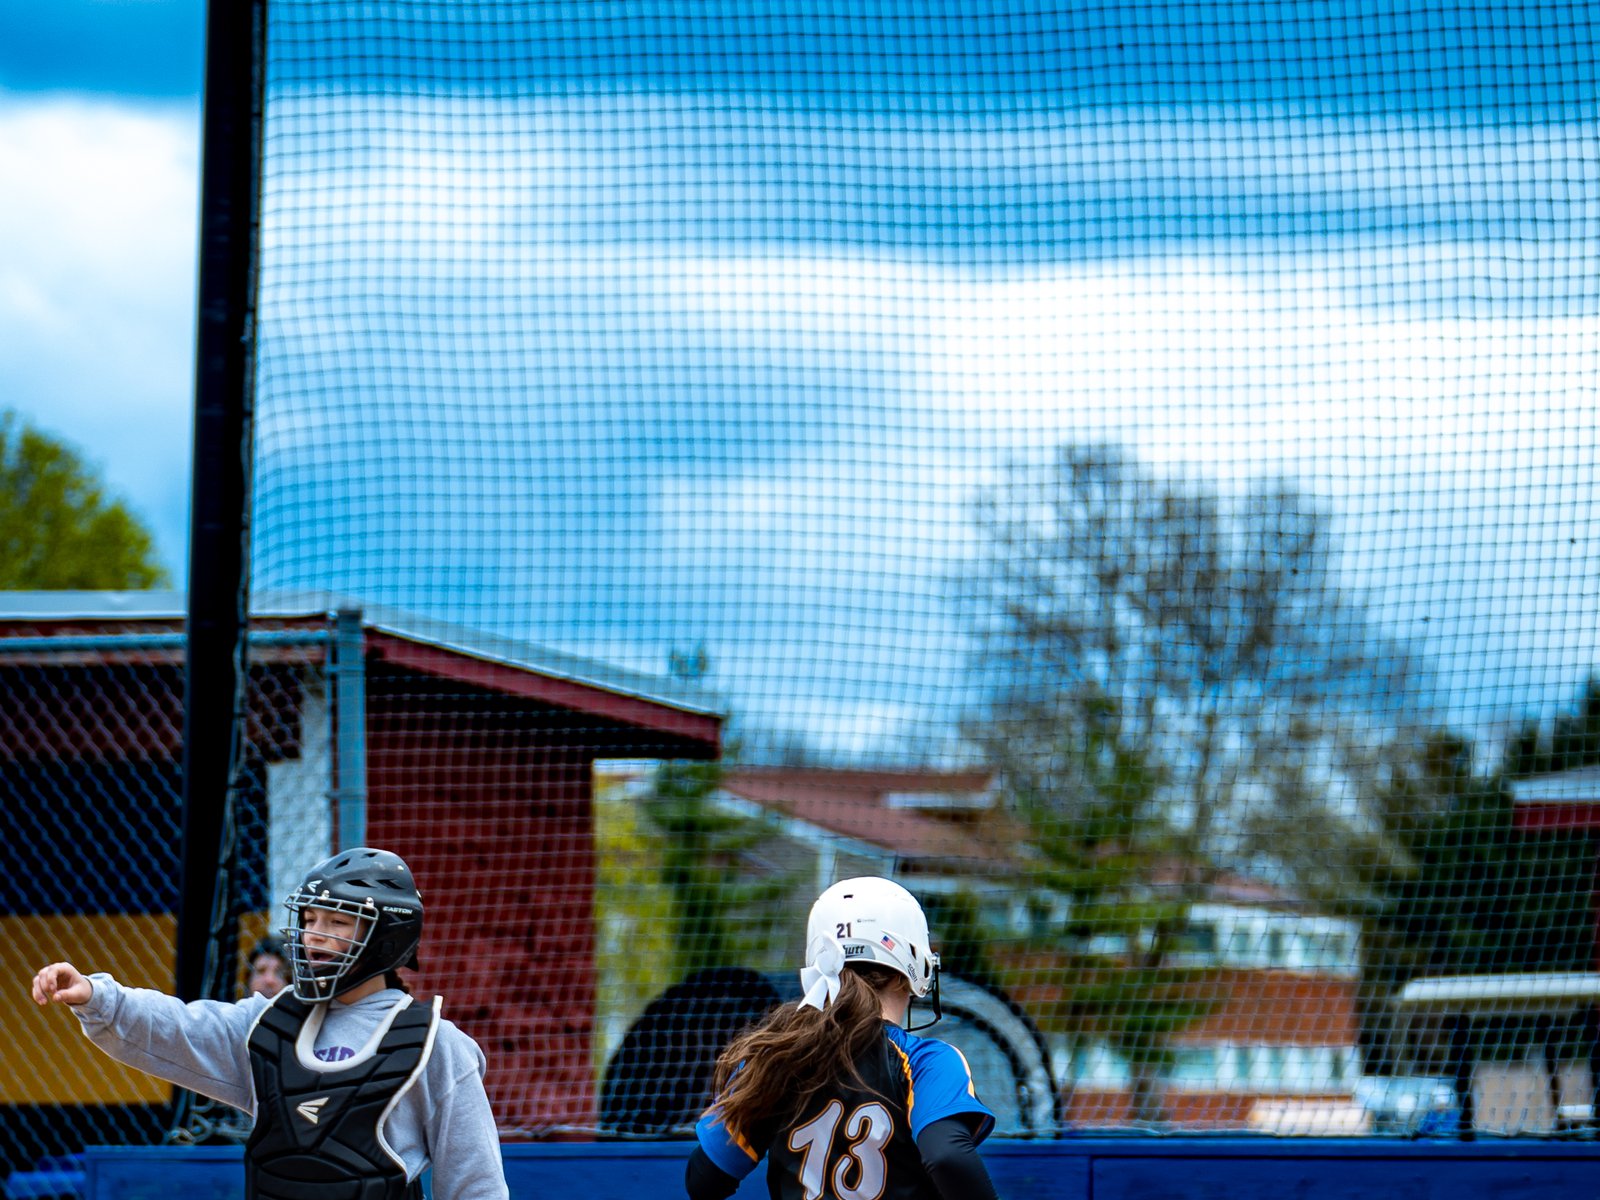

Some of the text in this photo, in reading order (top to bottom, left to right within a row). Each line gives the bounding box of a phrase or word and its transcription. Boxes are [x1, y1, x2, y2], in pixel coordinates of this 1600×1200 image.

[382, 905, 413, 914] EASTON
[836, 922, 851, 939] 21
[843, 944, 865, 955] hutt
